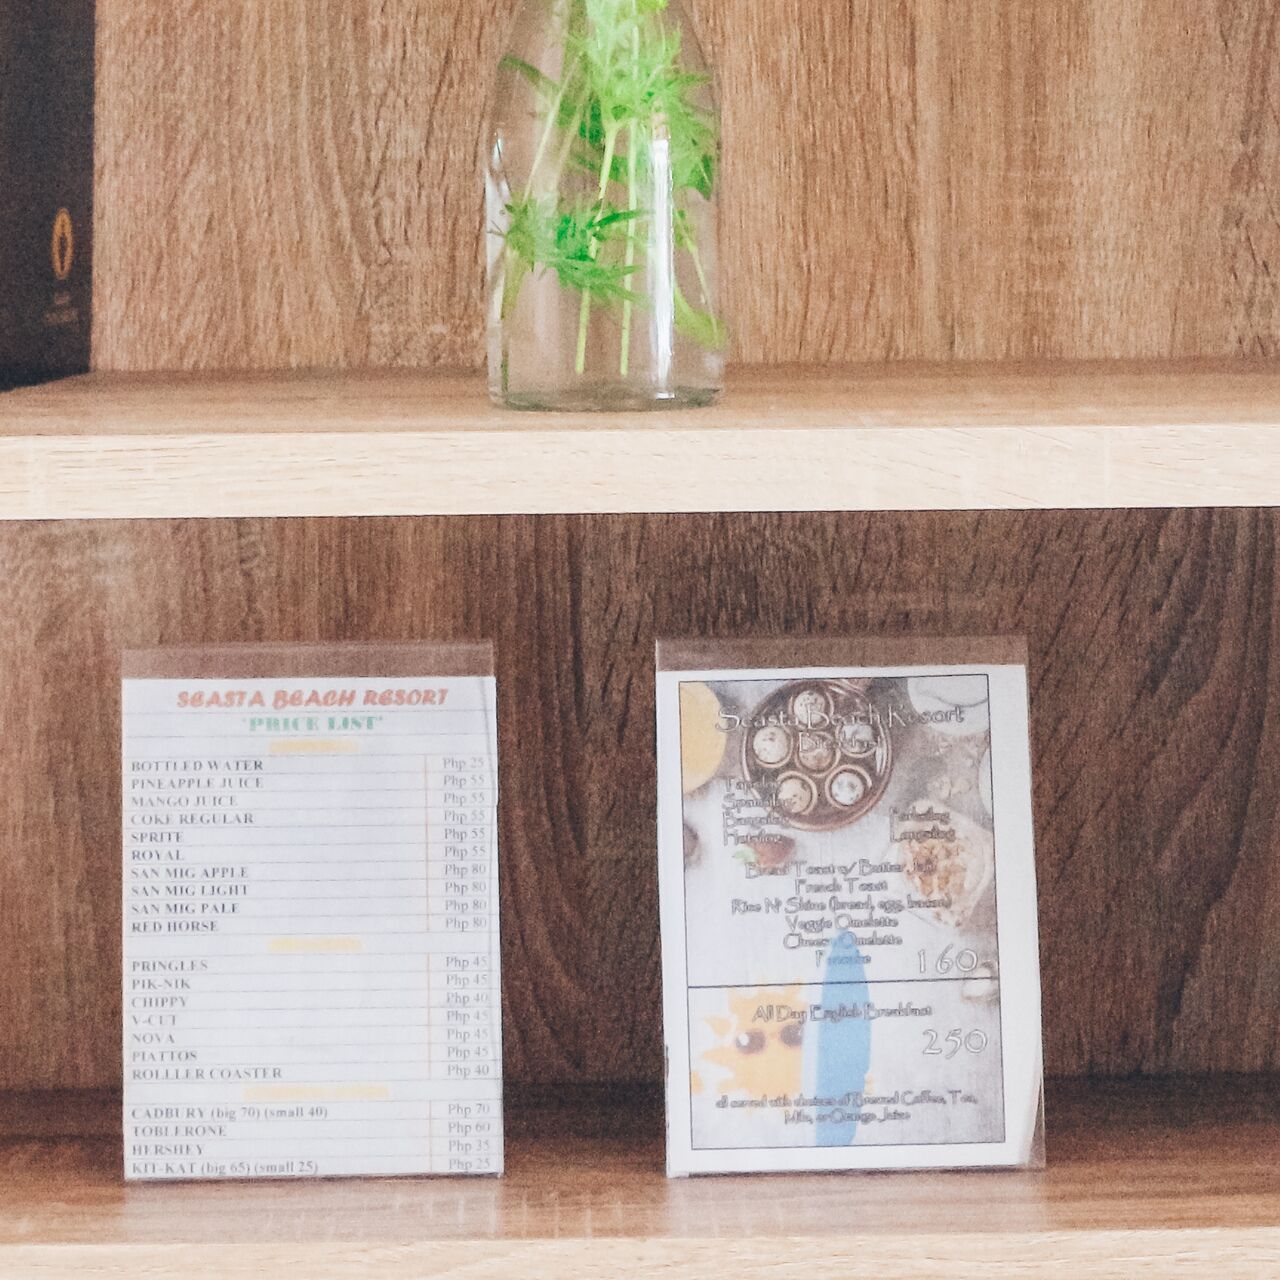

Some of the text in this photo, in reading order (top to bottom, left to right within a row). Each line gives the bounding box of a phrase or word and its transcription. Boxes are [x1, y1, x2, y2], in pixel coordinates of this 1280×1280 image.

[272, 689, 356, 710] BEACH
[363, 688, 448, 706] RESORT
[131, 760, 263, 771] BOTTLED WATER
[443, 757, 483, 770] Php 25
[131, 778, 264, 789] PINEAPPLE JUICE
[443, 774, 484, 788] Php 55
[131, 796, 238, 807] MANGO JUICE
[444, 792, 484, 806] Php 55
[131, 813, 254, 825] COKE REGULAR
[444, 810, 485, 824] Php 55
[131, 832, 184, 843] SPRITE
[444, 828, 485, 842] Php 55
[132, 849, 185, 861] ROYAL
[445, 845, 486, 860] Php 55
[131, 866, 249, 879] SAN MIG APPLE
[445, 863, 486, 878] Php 80
[131, 884, 248, 896] SAN MIG LIGHT
[445, 882, 486, 895] Php 80
[131, 902, 240, 914] SAN MIG PALE
[445, 900, 486, 913] Php 80
[132, 920, 218, 933] RED HORSE
[446, 917, 486, 932] Php 80
[446, 956, 488, 971] Php 45
[918, 944, 978, 973] 160
[132, 960, 208, 972] PRINGLES
[132, 979, 190, 990] PIK-NIK
[446, 974, 488, 988] Php 45
[132, 996, 188, 1007] CHIPPY
[447, 992, 488, 1006] Php 40
[447, 1010, 488, 1025] Php 45
[777, 1006, 807, 1025] Day
[864, 1002, 933, 1020] Breakfast
[132, 1015, 176, 1026] V-CUT
[132, 1033, 175, 1044] NOVA
[447, 1028, 488, 1043] Php 45
[922, 1028, 988, 1059] 250
[132, 1050, 197, 1062] PIATTOS
[448, 1046, 488, 1061] Php 45
[210, 1068, 282, 1079] COASTER
[448, 1064, 489, 1078] Php 40
[132, 1107, 328, 1120] CADBURY (big 70) (small 40)
[448, 1103, 489, 1118] Php 70
[133, 1126, 227, 1137] TOBLERONE
[449, 1121, 490, 1137] Php 60
[132, 1144, 204, 1155] HERSHEY
[449, 1140, 490, 1154] Php 35
[132, 1161, 318, 1175] KIT-KAT (big 65) (small 25)
[449, 1158, 490, 1171] Php 25
